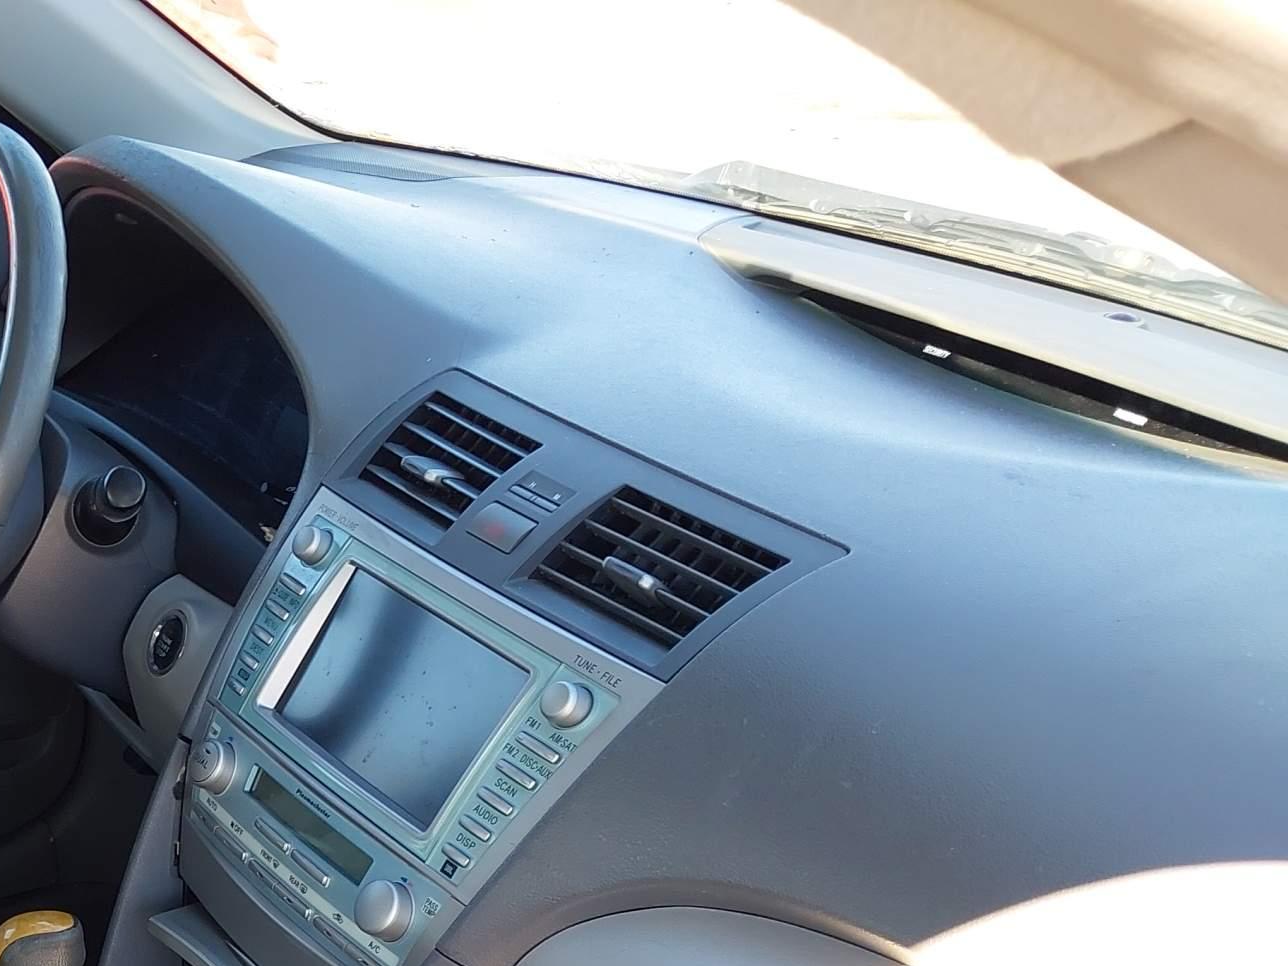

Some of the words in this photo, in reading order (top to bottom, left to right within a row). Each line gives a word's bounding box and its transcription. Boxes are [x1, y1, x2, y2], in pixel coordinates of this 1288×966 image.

[572, 654, 598, 674] TUNE
[600, 671, 623, 689] FILE
[524, 716, 542, 731] FM1
[502, 742, 520, 759] FM2
[494, 777, 519, 798] SCAN
[472, 804, 499, 826] AUDIO
[455, 832, 477, 850] DISP
[425, 897, 440, 912] PASS
[367, 940, 381, 955] A/C
